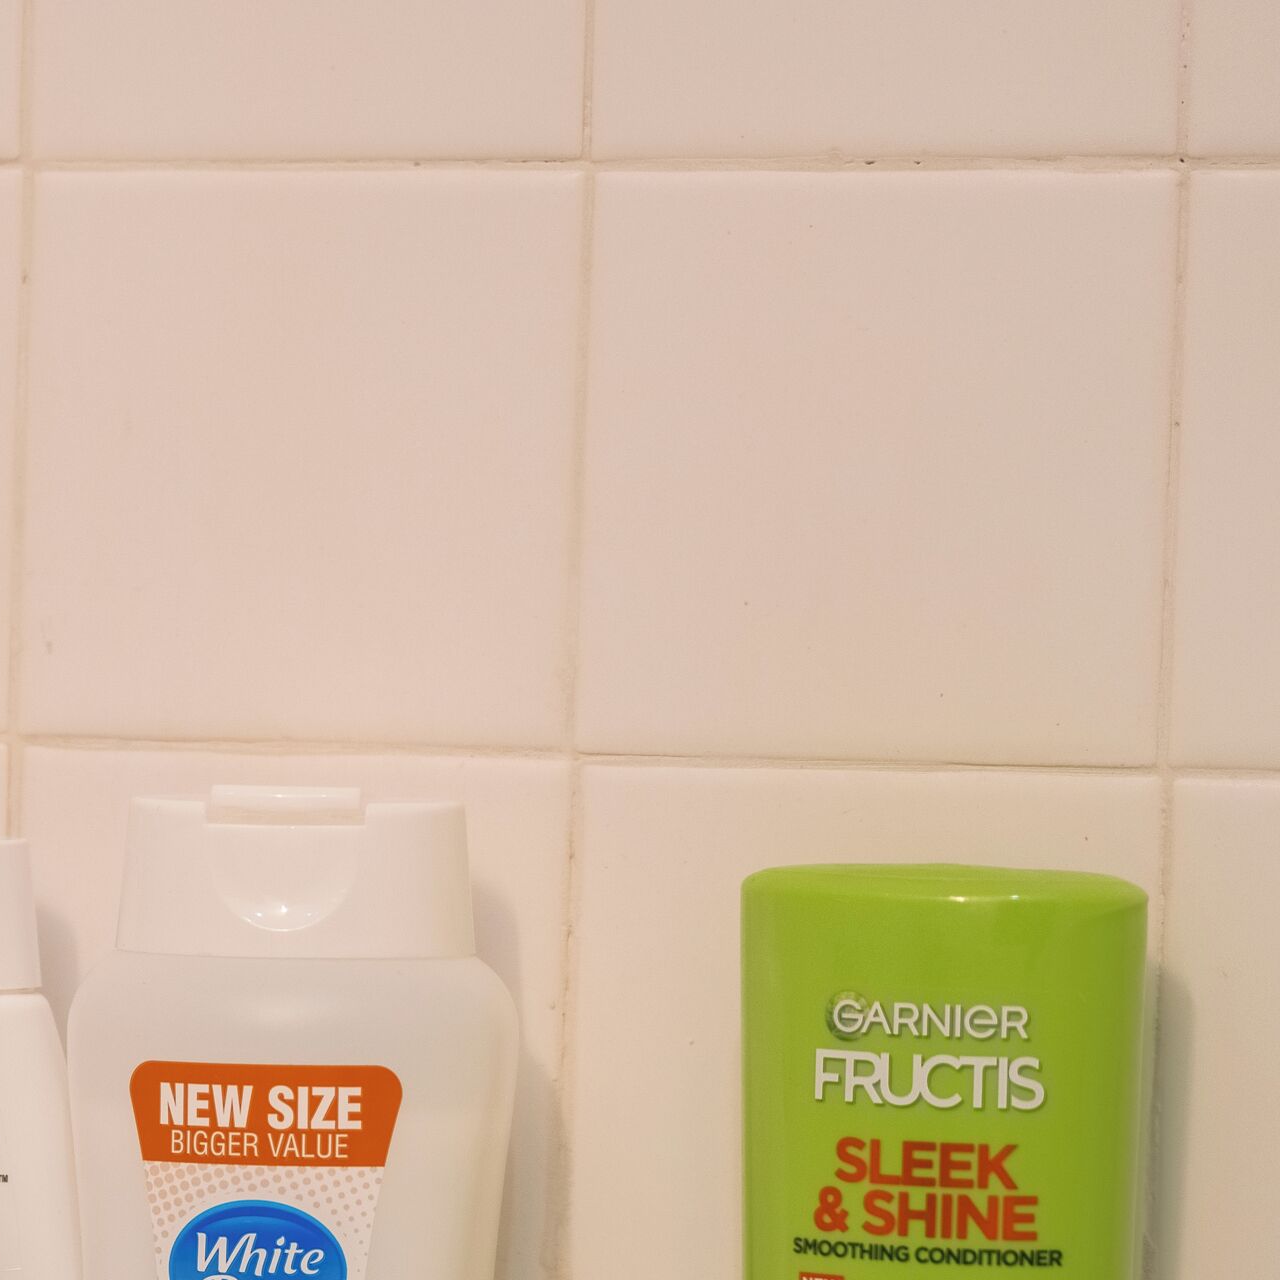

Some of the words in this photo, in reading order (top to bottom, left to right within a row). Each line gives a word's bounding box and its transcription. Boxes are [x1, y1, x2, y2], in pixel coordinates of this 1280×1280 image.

[833, 999, 1029, 1039] GARNIER
[814, 1048, 1045, 1111] FRUCTIS
[160, 1082, 254, 1128] NEW
[267, 1085, 362, 1130] SIZE
[171, 1130, 258, 1157] BIGGER
[268, 1133, 348, 1159] VALUE
[834, 1136, 1018, 1190] SLEEK
[813, 1186, 849, 1233] &
[862, 1189, 1038, 1241] SHINE
[196, 1232, 324, 1277] White
[793, 1237, 909, 1263] SMOOTHING
[915, 1246, 1063, 1267] CONDITIONER
